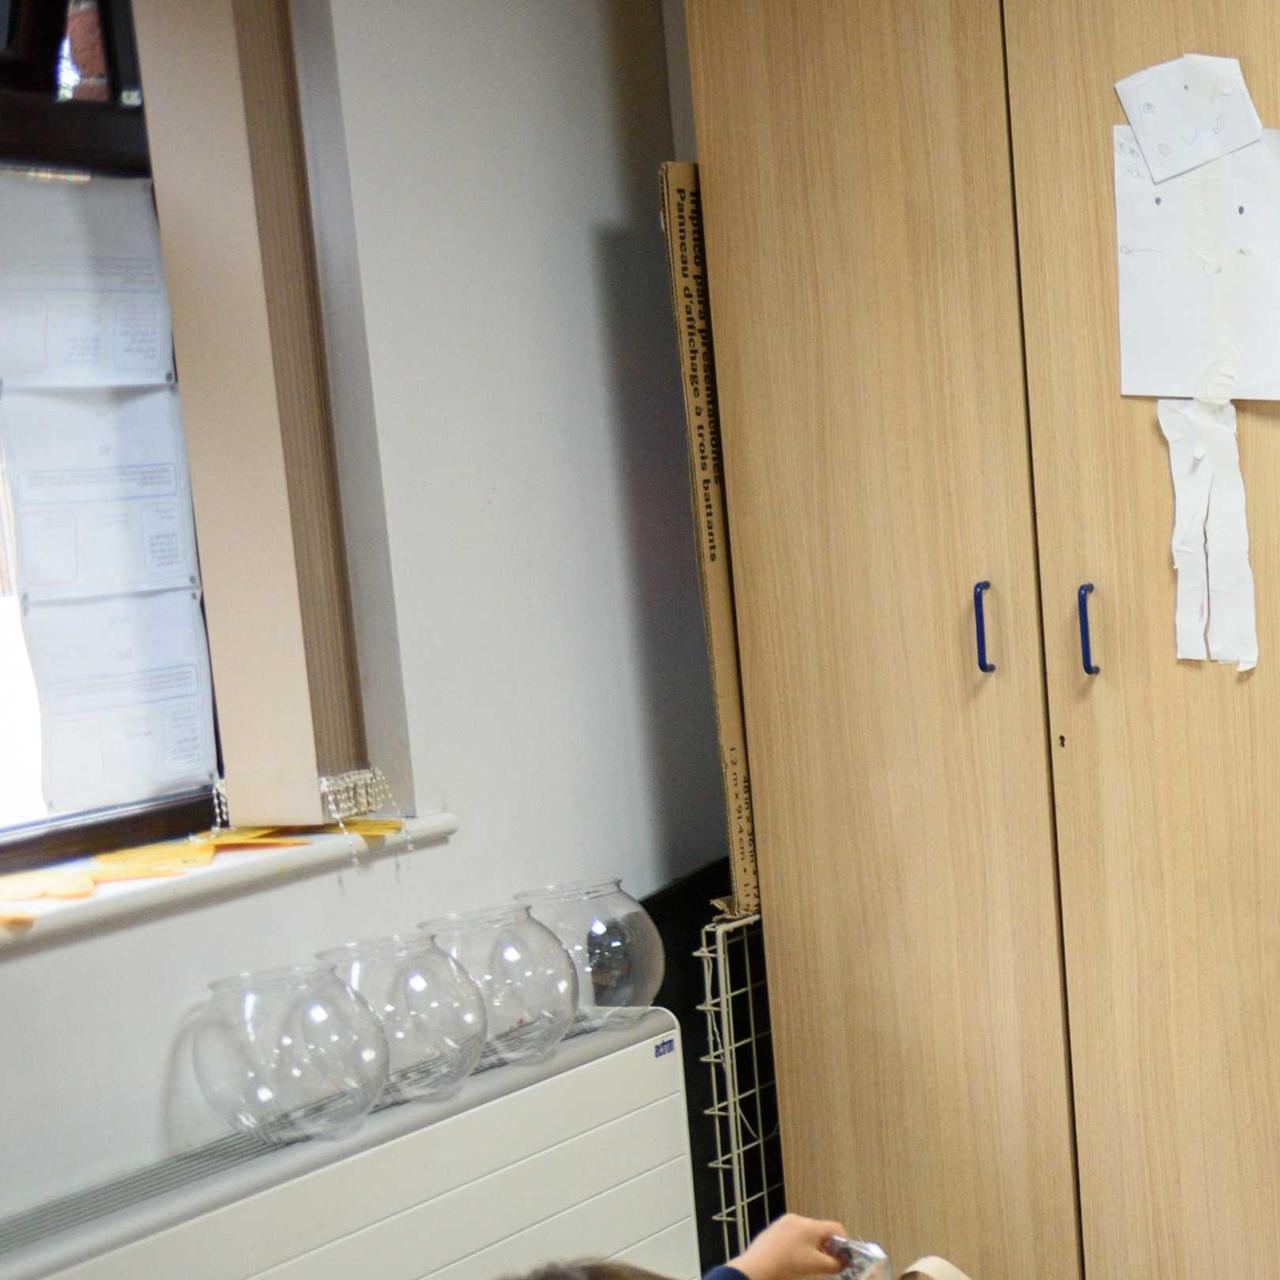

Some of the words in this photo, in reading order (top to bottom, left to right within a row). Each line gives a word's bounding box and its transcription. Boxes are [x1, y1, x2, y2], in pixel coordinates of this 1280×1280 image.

[676, 188, 692, 279] Panneau
[696, 424, 709, 472] trois
[701, 479, 718, 562] battants
